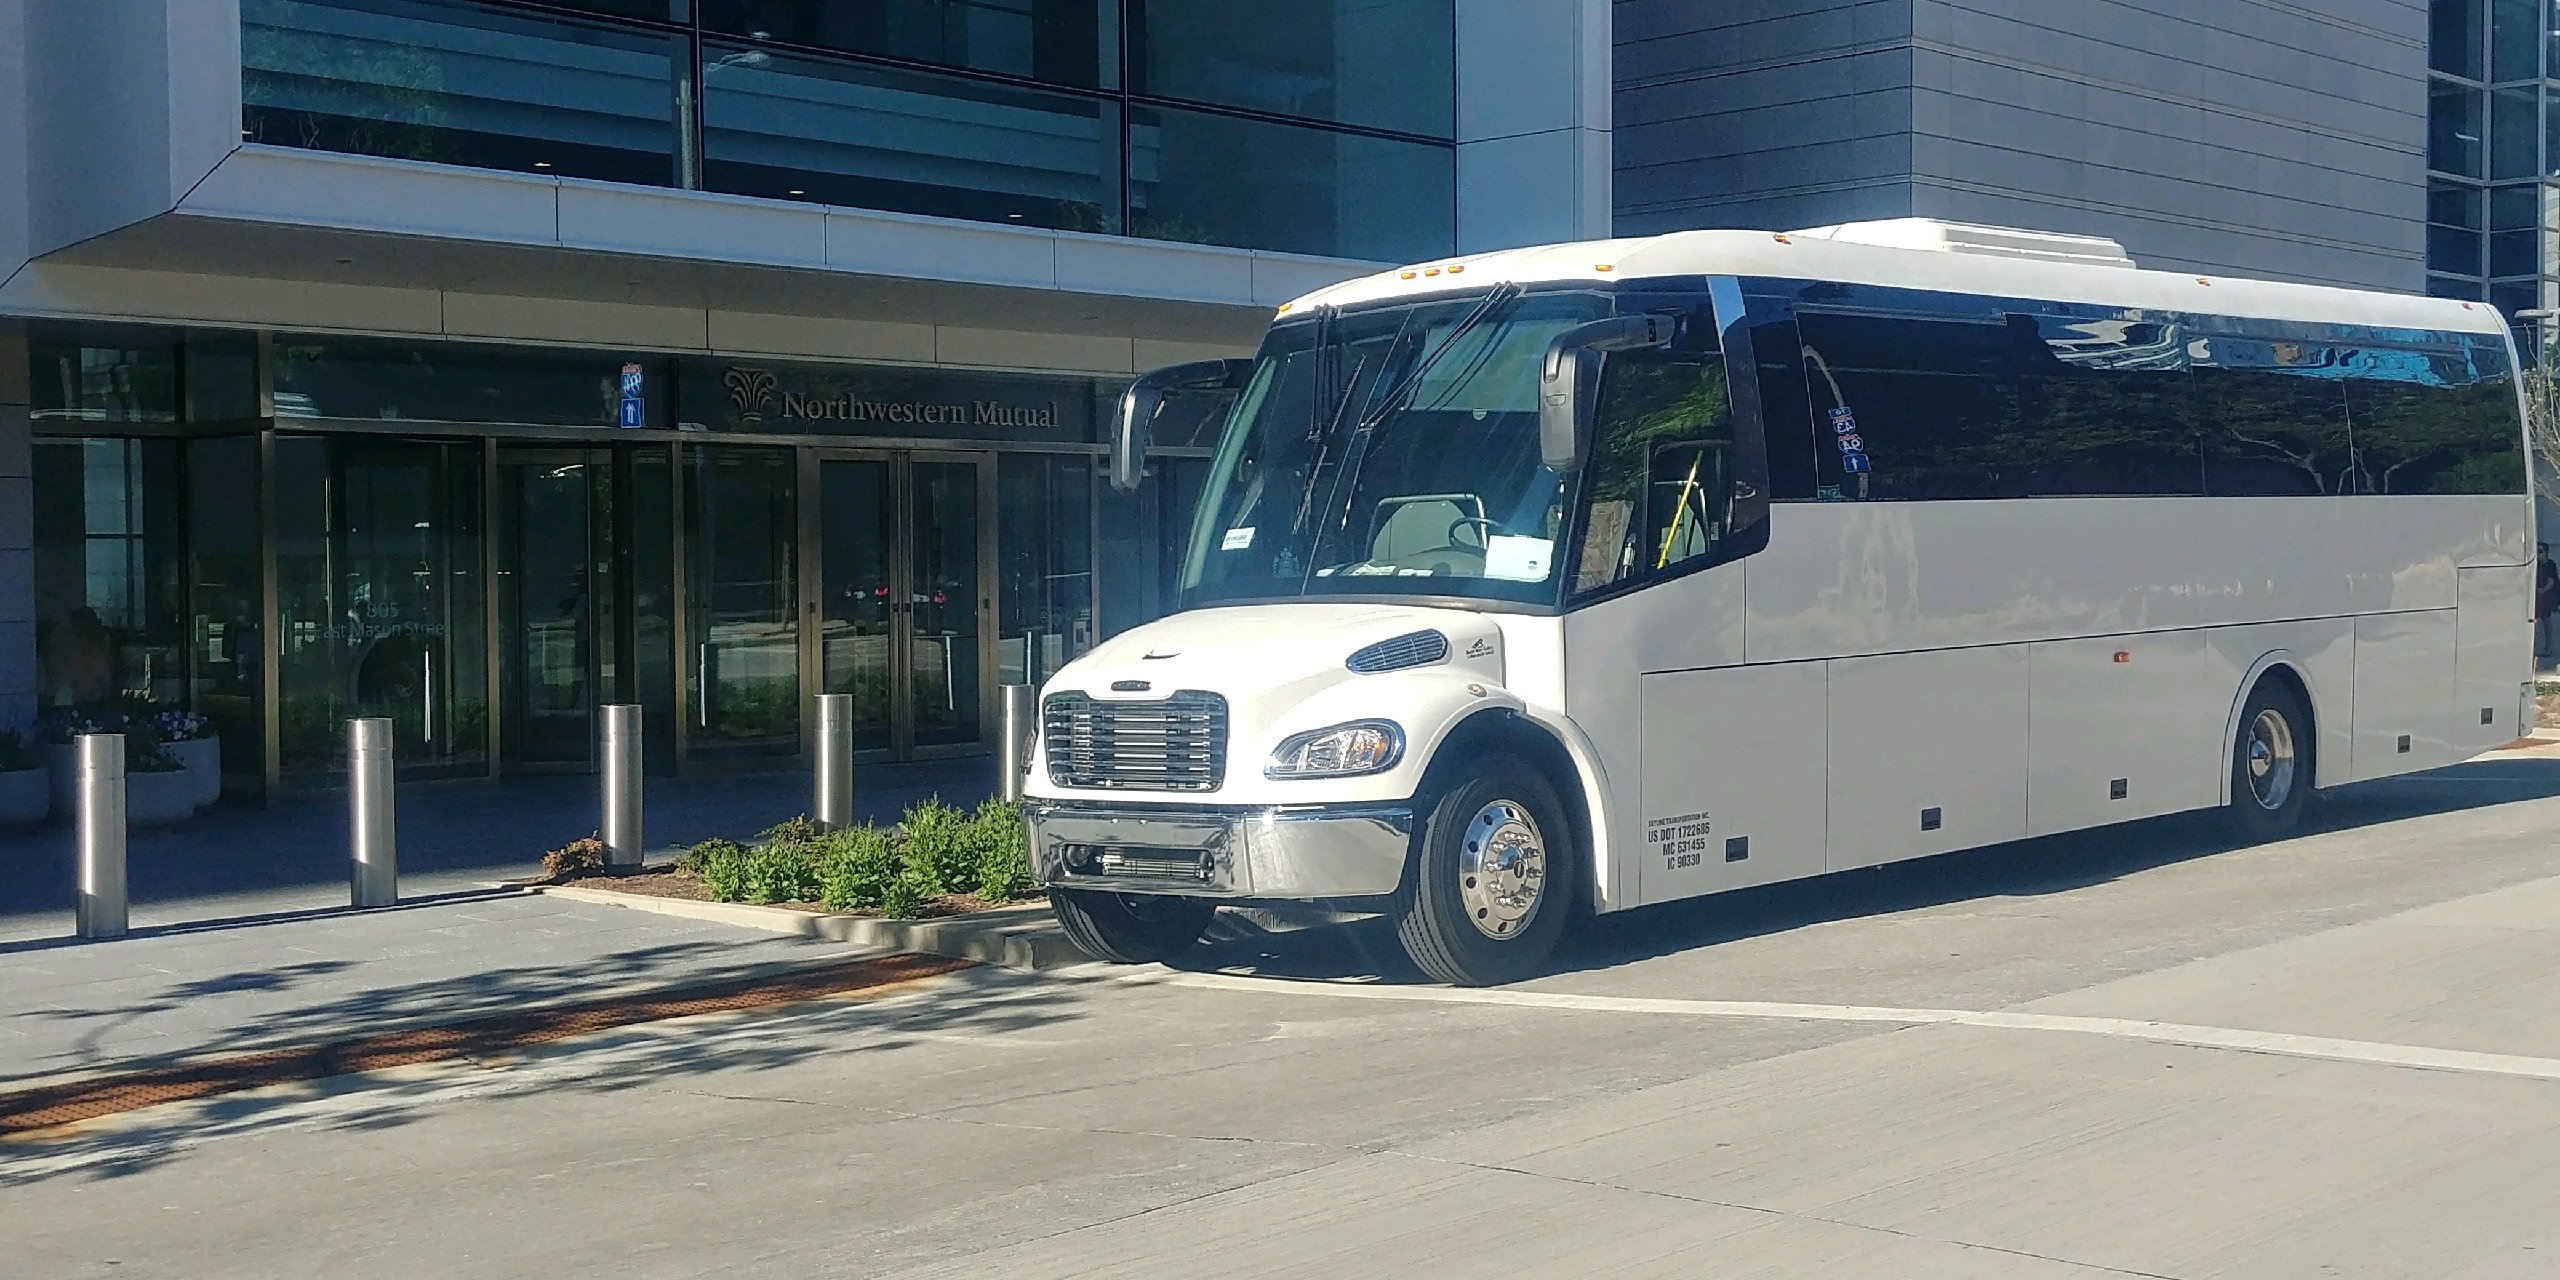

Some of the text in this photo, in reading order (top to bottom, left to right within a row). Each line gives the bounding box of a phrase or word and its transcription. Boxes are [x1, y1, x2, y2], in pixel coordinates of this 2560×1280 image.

[783, 392, 1060, 428] Northwestern Mutual
[366, 603, 399, 618] 805
[350, 623, 401, 637] Mason
[404, 620, 450, 636] Stree
[1648, 830, 1659, 843] US
[1660, 827, 1676, 841] DOT
[1663, 838, 1705, 856] MC 631455
[1667, 853, 1700, 871] IC 90330
